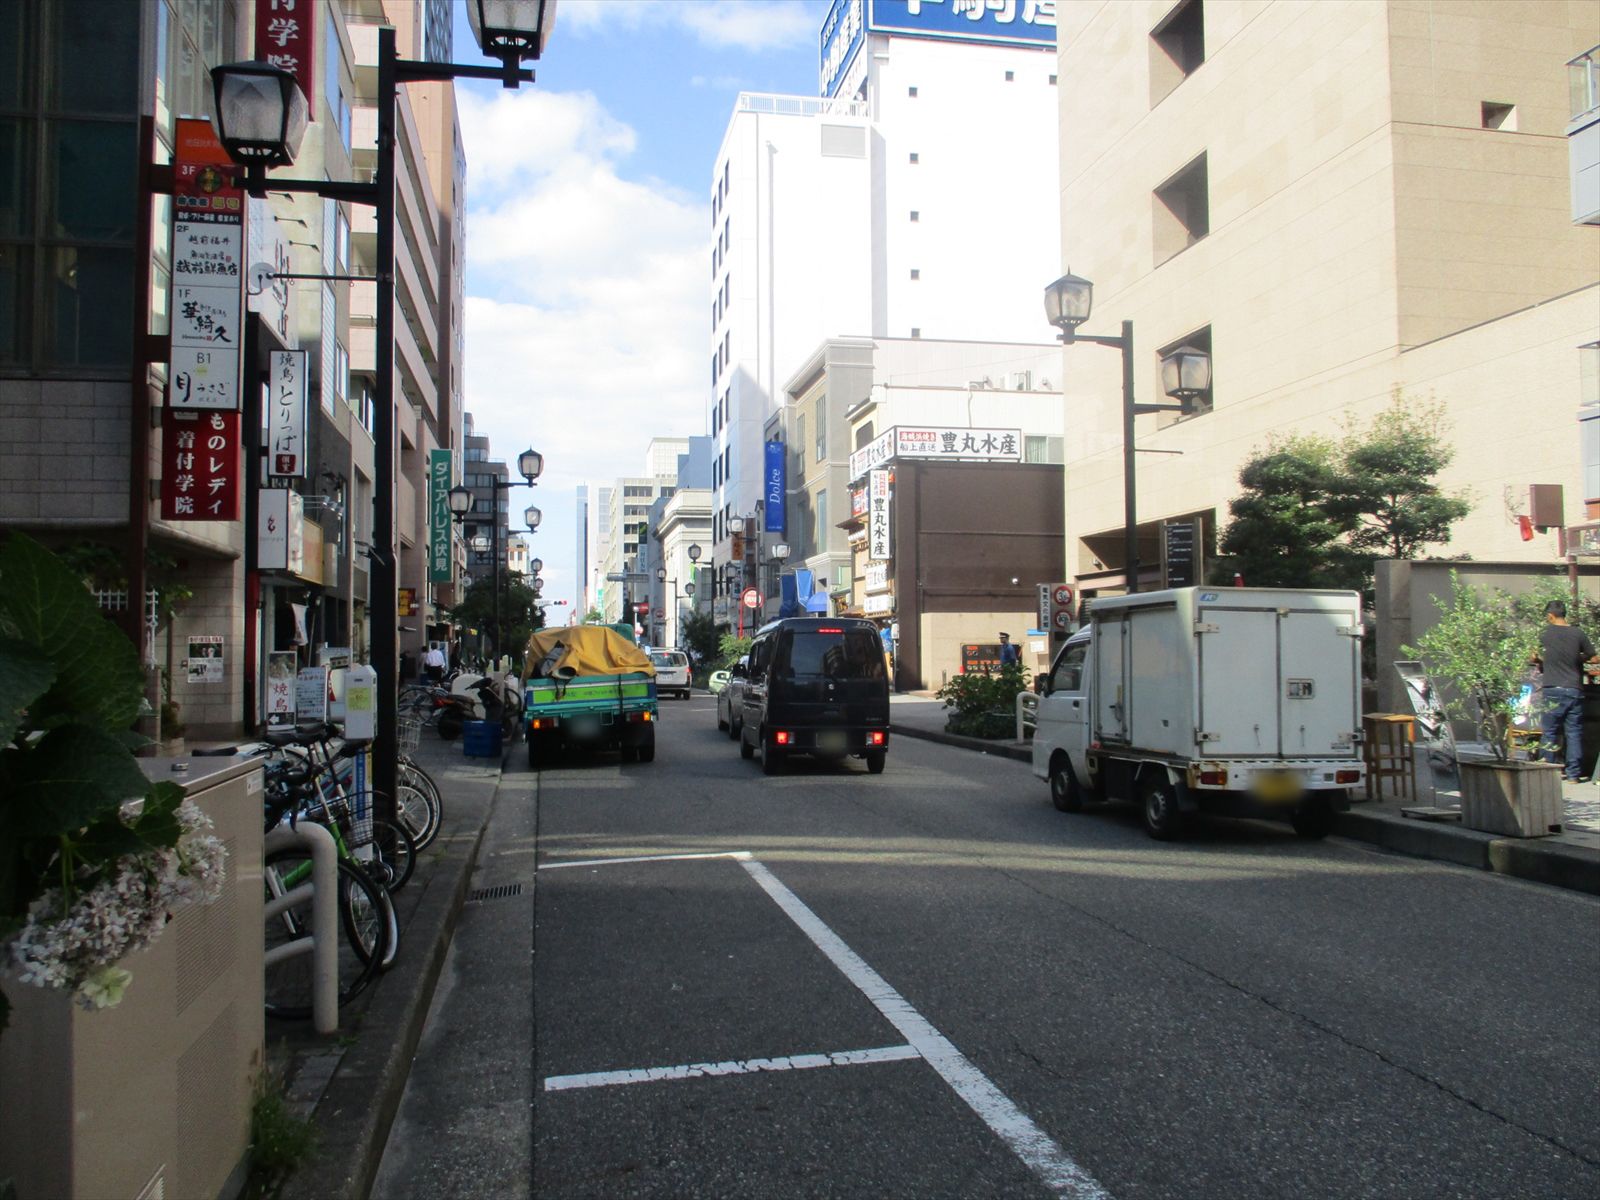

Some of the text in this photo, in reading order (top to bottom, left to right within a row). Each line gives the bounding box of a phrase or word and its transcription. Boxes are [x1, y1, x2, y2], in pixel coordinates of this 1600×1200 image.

[181, 166, 196, 176] 3F
[176, 225, 189, 233] 2F
[176, 259, 238, 276] 越前鮮魚店
[178, 288, 191, 298] 1F
[196, 352, 211, 364] B1
[900, 442, 936, 452] 船上直送
[940, 432, 1018, 454] 豊丸水産
[175, 431, 195, 514] 着付学院
[769, 468, 781, 504] Dolce
[873, 498, 887, 555] 豊丸水産
[273, 683, 289, 712] 焼鳥
